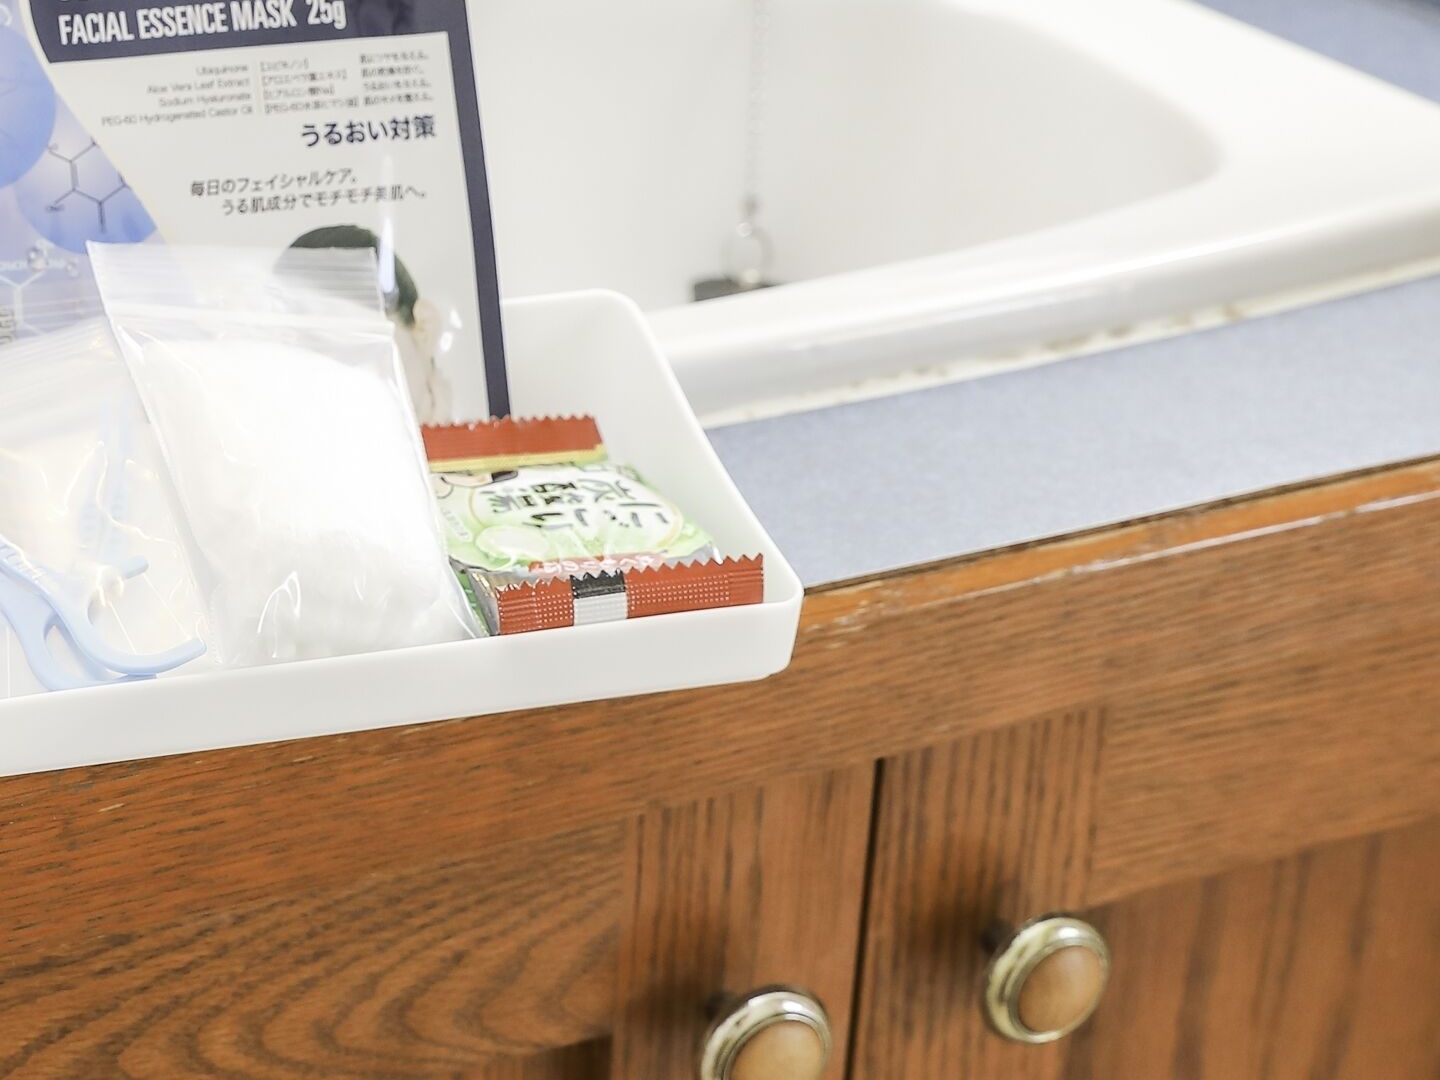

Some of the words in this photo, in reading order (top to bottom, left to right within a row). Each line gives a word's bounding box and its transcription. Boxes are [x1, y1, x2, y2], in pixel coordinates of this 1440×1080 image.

[58, 11, 134, 45] FACIAL
[137, 1, 229, 39] ESSENCE
[302, 114, 435, 147] うるおい対策
